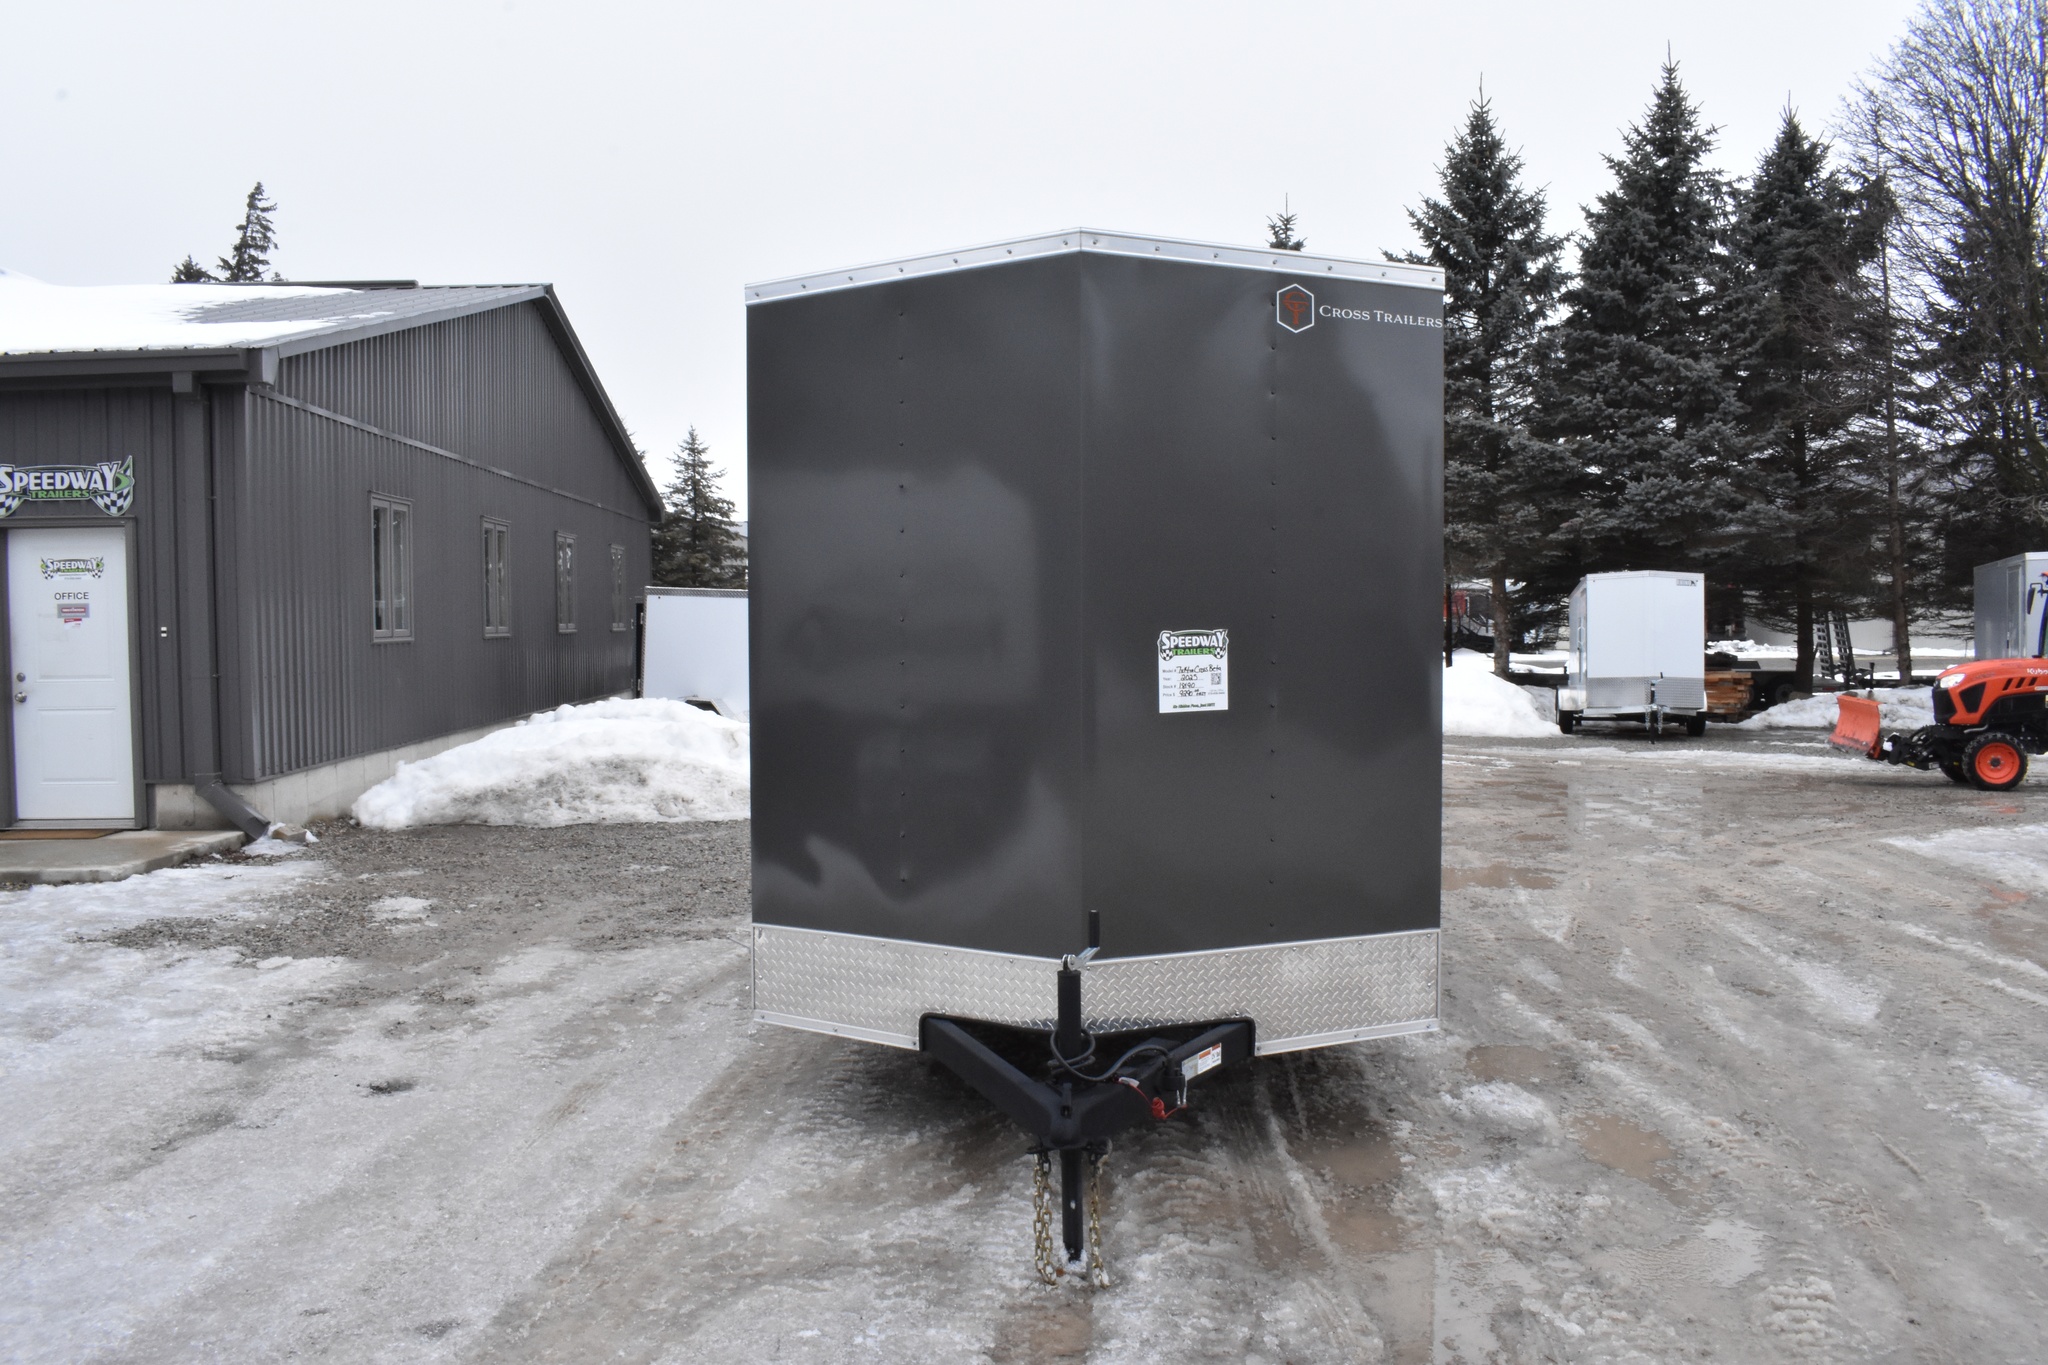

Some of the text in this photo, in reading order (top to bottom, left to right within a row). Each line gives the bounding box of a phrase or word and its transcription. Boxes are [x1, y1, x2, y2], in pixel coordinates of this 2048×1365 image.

[1319, 305, 1443, 328] CROSS TRAILERS
[0, 462, 119, 493] SPEEDWAY
[30, 489, 90, 499] TRAILERS
[47, 558, 97, 571] SPEEDWAY
[54, 592, 89, 601] OFFICE
[1161, 631, 1224, 650] SPEEDWAY
[1172, 648, 1216, 656] TRAILERS
[1181, 673, 1198, 681] 2025
